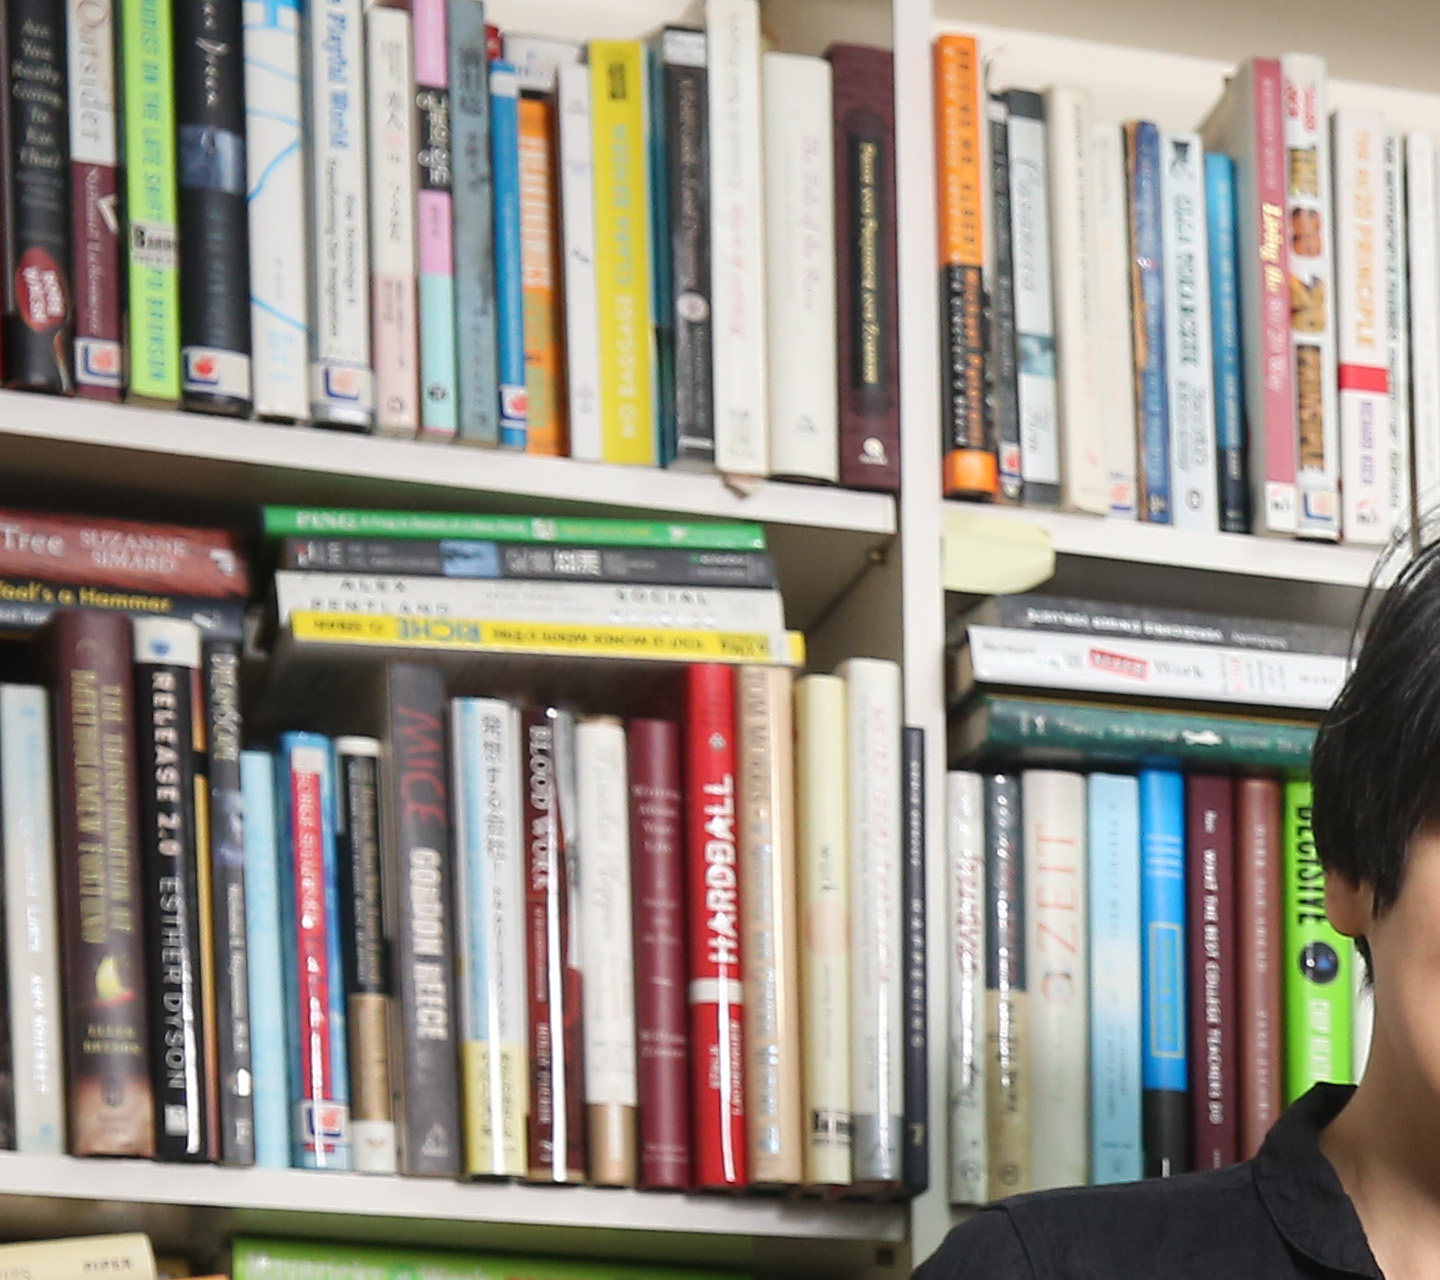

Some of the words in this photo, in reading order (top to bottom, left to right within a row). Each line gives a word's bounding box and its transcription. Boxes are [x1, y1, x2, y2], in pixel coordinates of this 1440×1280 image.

[1290, 147, 1319, 198] THE
[615, 216, 632, 285] CLARA
[1260, 203, 1285, 262] Living
[1355, 224, 1376, 348] PRINCIPLE
[615, 294, 636, 398] BAGGAGE
[616, 404, 636, 438] NO
[1297, 345, 1325, 471] PRINCIPLE
[1, 520, 67, 558] Tree
[80, 529, 190, 556] SUZANNE
[90, 551, 181, 575] SIMARD
[88, 584, 172, 613] Hammer
[151, 671, 178, 801] RELEASE
[397, 708, 444, 827] MICE
[529, 724, 550, 810] BLOOD
[157, 812, 178, 857] 2.0
[531, 818, 551, 892] WORK
[702, 773, 736, 963] HARDBALL
[409, 847, 445, 956] GORDON
[1034, 822, 1080, 956] ZEIT
[158, 876, 183, 985] ESTHER
[162, 992, 187, 1089] DYSON
[414, 963, 448, 1041] REECE
